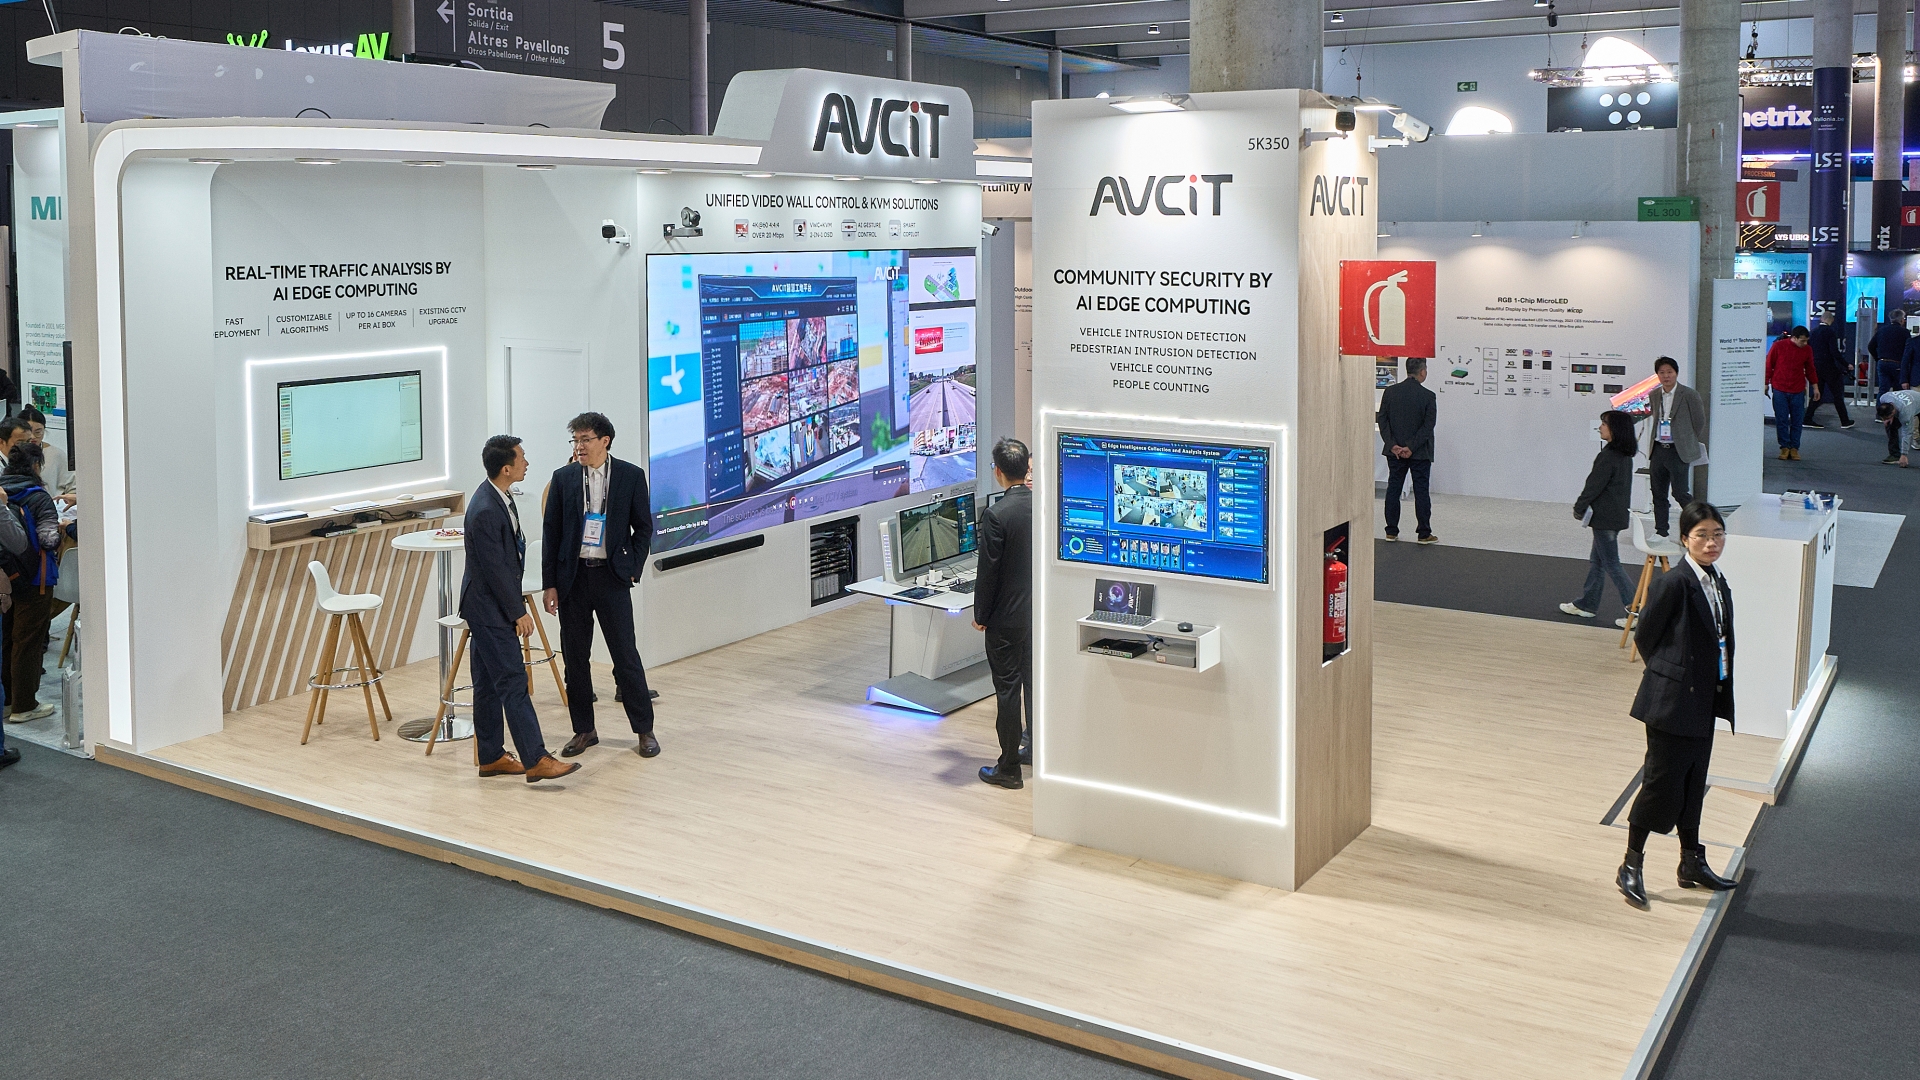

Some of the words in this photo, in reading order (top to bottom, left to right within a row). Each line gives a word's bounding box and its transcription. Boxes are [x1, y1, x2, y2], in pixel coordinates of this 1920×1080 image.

[468, 2, 514, 22] Sortida
[468, 19, 489, 29] Salida
[496, 23, 510, 31] Exit
[468, 31, 508, 48] Altres
[515, 36, 570, 56] Pavellons
[602, 21, 625, 70] 5
[468, 46, 487, 57] Otros
[488, 50, 523, 60] Pabellones
[530, 54, 548, 63] Other
[550, 56, 566, 65] Halls
[812, 92, 949, 159] AVCiT
[1248, 137, 1290, 151] 5K350
[1815, 152, 1842, 168] LSE
[706, 194, 750, 208] UNIFIED
[752, 195, 784, 208] VIDEO
[786, 196, 814, 209] WALL
[816, 196, 860, 210] CONTROL
[861, 197, 868, 210] &
[870, 197, 890, 210] KVM
[892, 198, 939, 210] SOLUTIONS
[1090, 174, 1233, 216] AVCiT
[1310, 174, 1368, 216] AVCiT
[31, 196, 62, 220] M
[1647, 208, 1659, 217] 5L
[1662, 208, 1681, 217] 300
[1812, 226, 1839, 242] LSE
[225, 265, 307, 280] REAL-TIME
[309, 263, 368, 278] TRAFFIC
[370, 262, 433, 277] ANALYSIS
[435, 261, 452, 274] BY
[1054, 268, 1156, 286] COMMUNITY
[1160, 271, 1244, 288] SECURITY
[1250, 272, 1273, 288] BY
[273, 287, 288, 301] AI
[292, 285, 331, 300] EDGE
[335, 282, 418, 299] COMPUTING
[419, 307, 449, 315] EXISTING
[1076, 295, 1092, 311] AI
[1097, 296, 1140, 312] EDGE
[1145, 297, 1251, 315] COMPUTING
[1810, 300, 1836, 316] LSE
[225, 318, 244, 326] FAST
[276, 313, 332, 323] CUSTOMIZABLE
[376, 310, 407, 318] CAMERAS
[213, 329, 261, 339] EPLOYMENT
[280, 325, 329, 334] ALGORITHMS
[1080, 327, 1122, 338] VEHICLE
[1124, 329, 1183, 340] INTRUSION
[1186, 331, 1246, 343] DETECTION
[1070, 343, 1132, 355] PEDESTRIAN
[1134, 346, 1194, 358] INTRUSION
[1196, 348, 1257, 361] DETECTION
[1110, 362, 1153, 374] VEHICLE
[1156, 364, 1213, 376] COUNTING
[1112, 379, 1150, 390] PEOPLE
[1153, 381, 1210, 393] COUNTING
